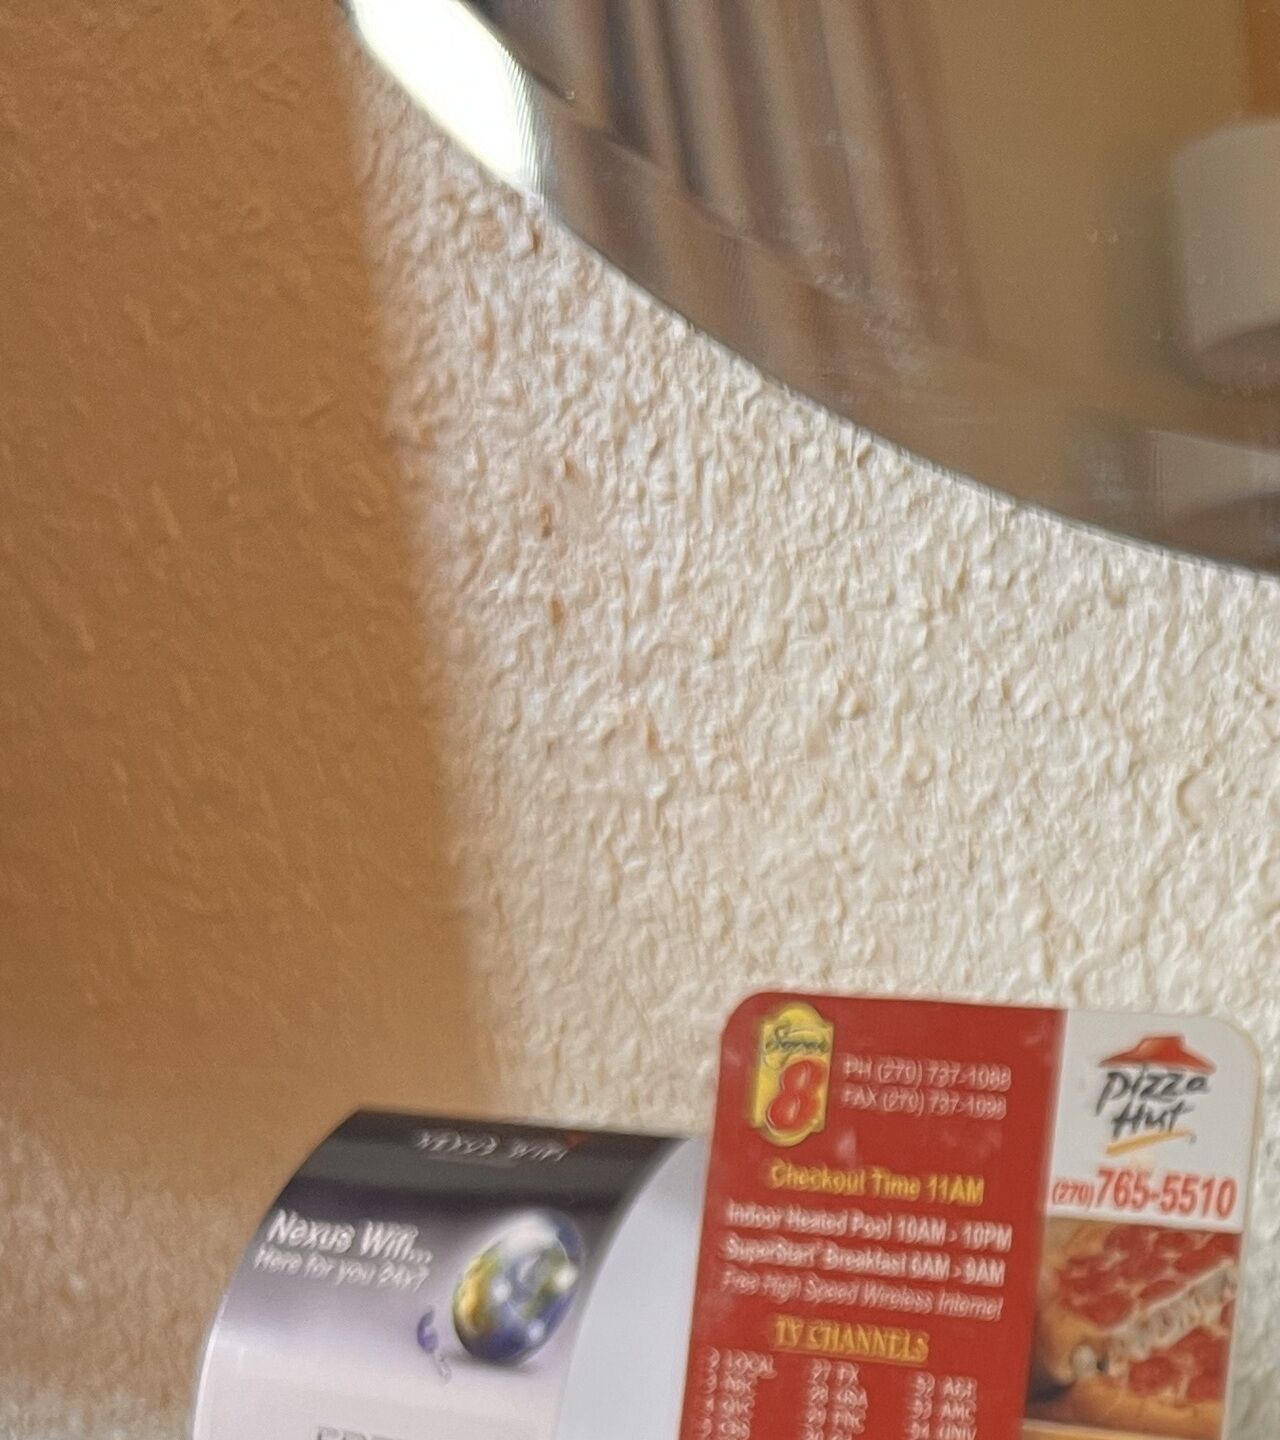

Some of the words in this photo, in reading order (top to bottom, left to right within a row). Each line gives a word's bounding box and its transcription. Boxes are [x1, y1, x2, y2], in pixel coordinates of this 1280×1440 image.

[1096, 1066, 1211, 1116] Pizza
[1111, 1100, 1194, 1140] Hut
[767, 1157, 865, 1196] Checkout
[870, 1166, 921, 1200] Time
[927, 1173, 985, 1206] 11AM
[1096, 1167, 1238, 1220] 765-5510
[266, 1208, 356, 1254] Nexus
[850, 1208, 893, 1240] Pool
